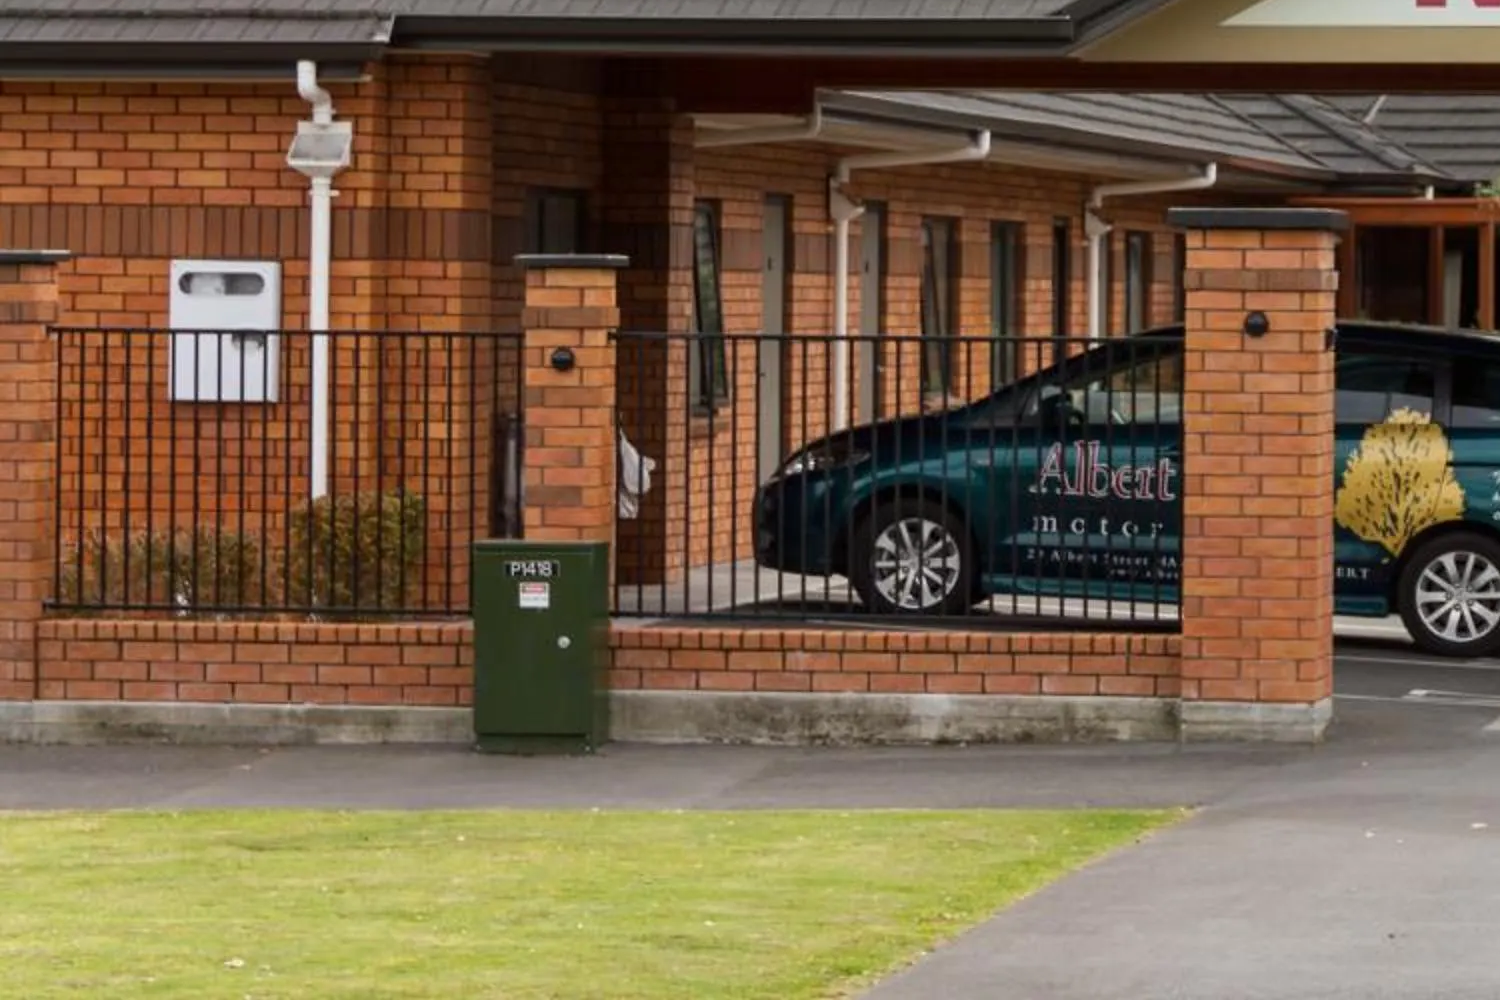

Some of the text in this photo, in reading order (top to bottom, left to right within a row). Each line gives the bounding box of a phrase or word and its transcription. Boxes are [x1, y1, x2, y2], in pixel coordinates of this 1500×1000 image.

[1029, 439, 1176, 501] Albert
[511, 561, 553, 577] P1418
[1336, 567, 1370, 579] ERT
